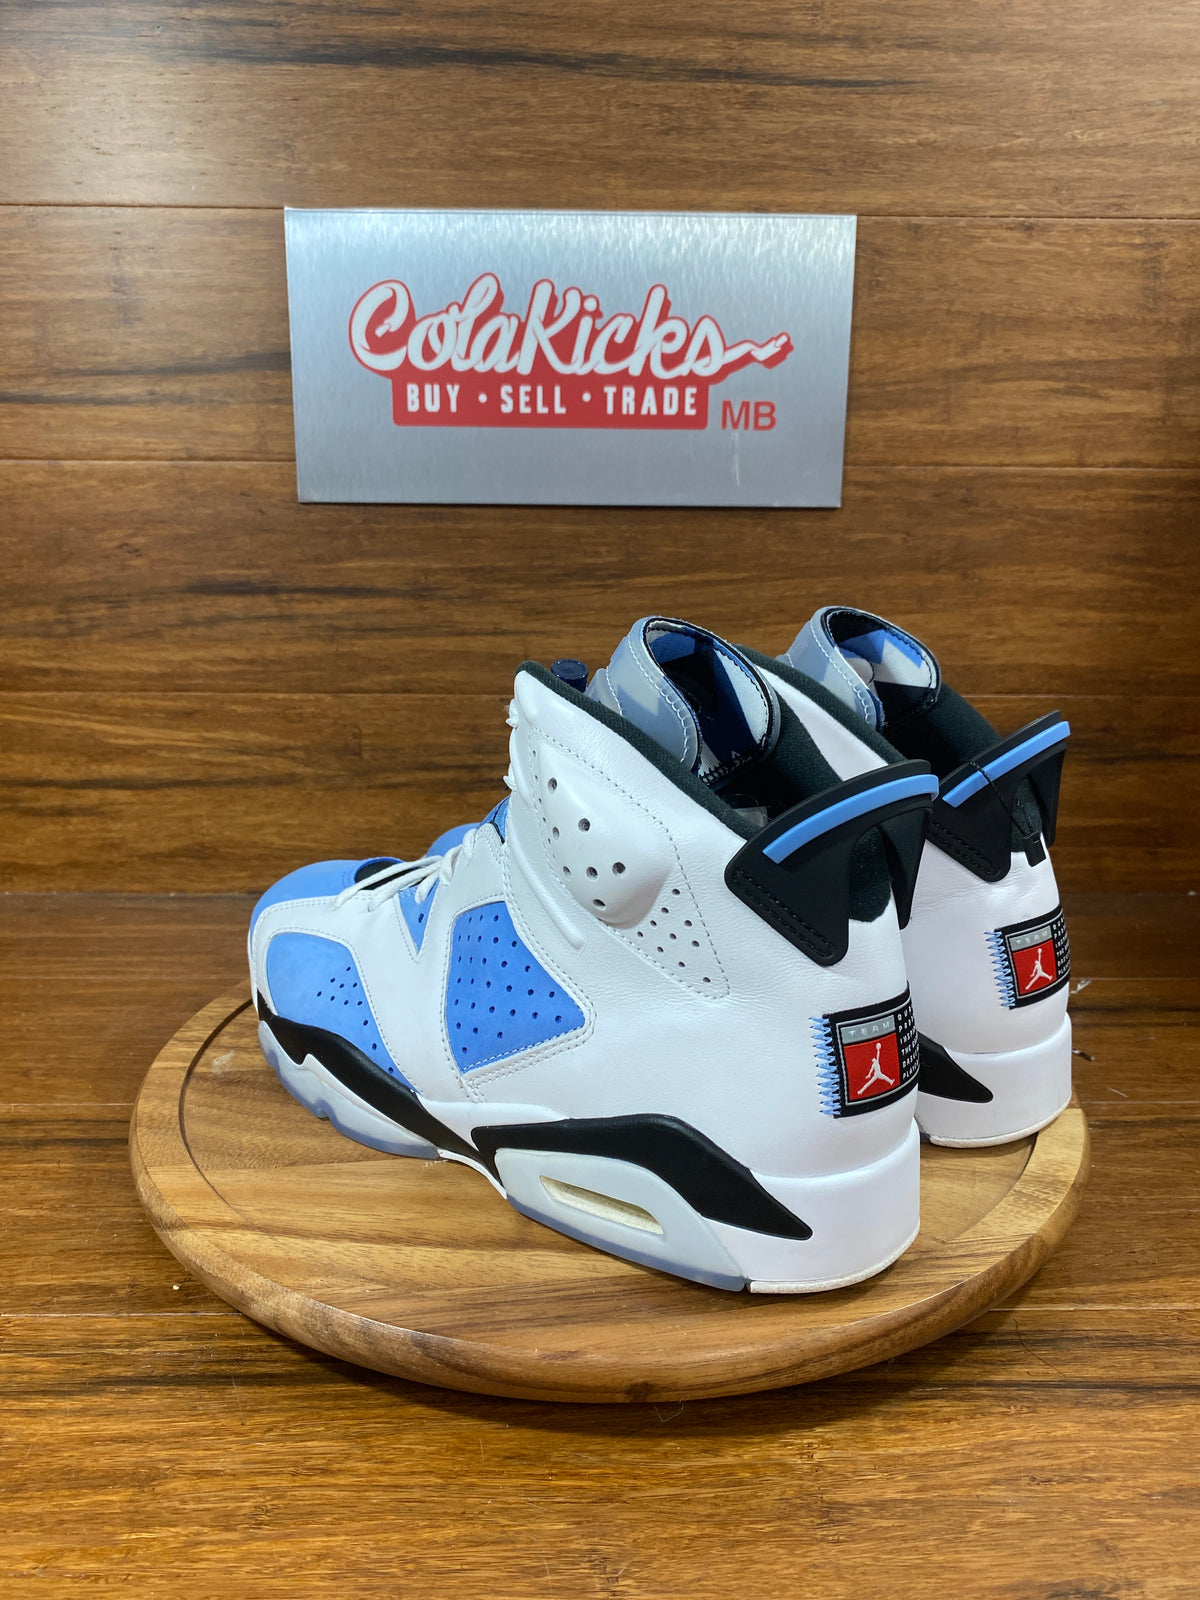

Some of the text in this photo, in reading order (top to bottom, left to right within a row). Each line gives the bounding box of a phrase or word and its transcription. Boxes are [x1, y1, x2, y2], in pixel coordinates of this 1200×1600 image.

[349, 272, 794, 378] ColaKicks
[406, 383, 698, 416] BUY SELL TRADE
[721, 400, 777, 431] MB
[848, 1021, 891, 1037] TEAM
